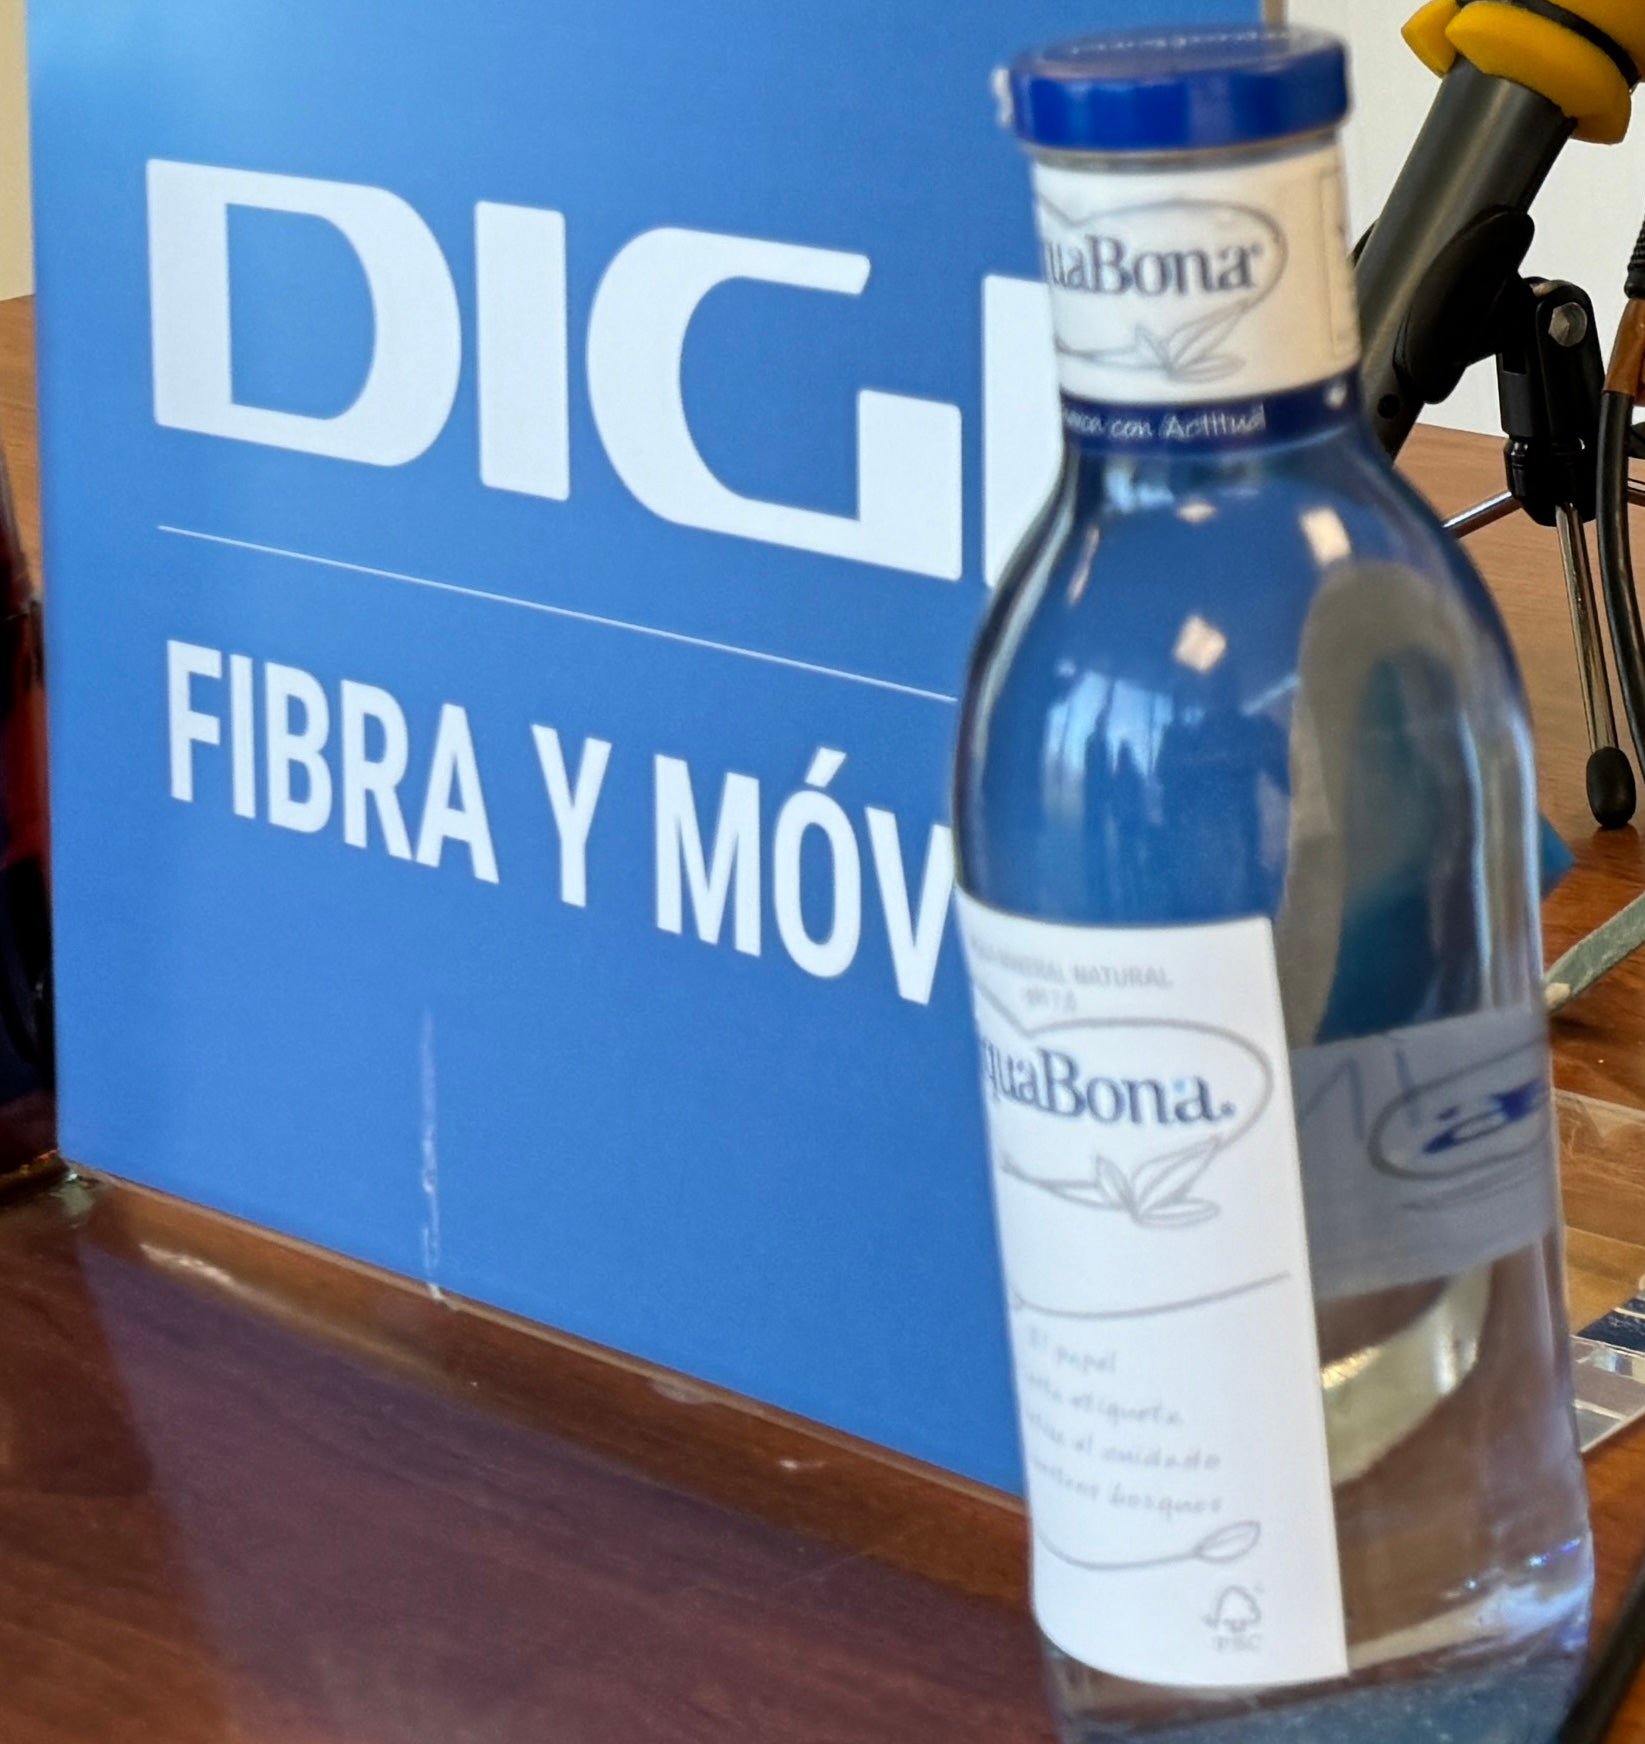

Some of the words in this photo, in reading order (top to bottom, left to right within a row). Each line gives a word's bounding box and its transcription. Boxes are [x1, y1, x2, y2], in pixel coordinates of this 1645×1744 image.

[146, 158, 1062, 588] DIGI
[166, 639, 499, 886] FIBRA
[531, 723, 612, 909] Y
